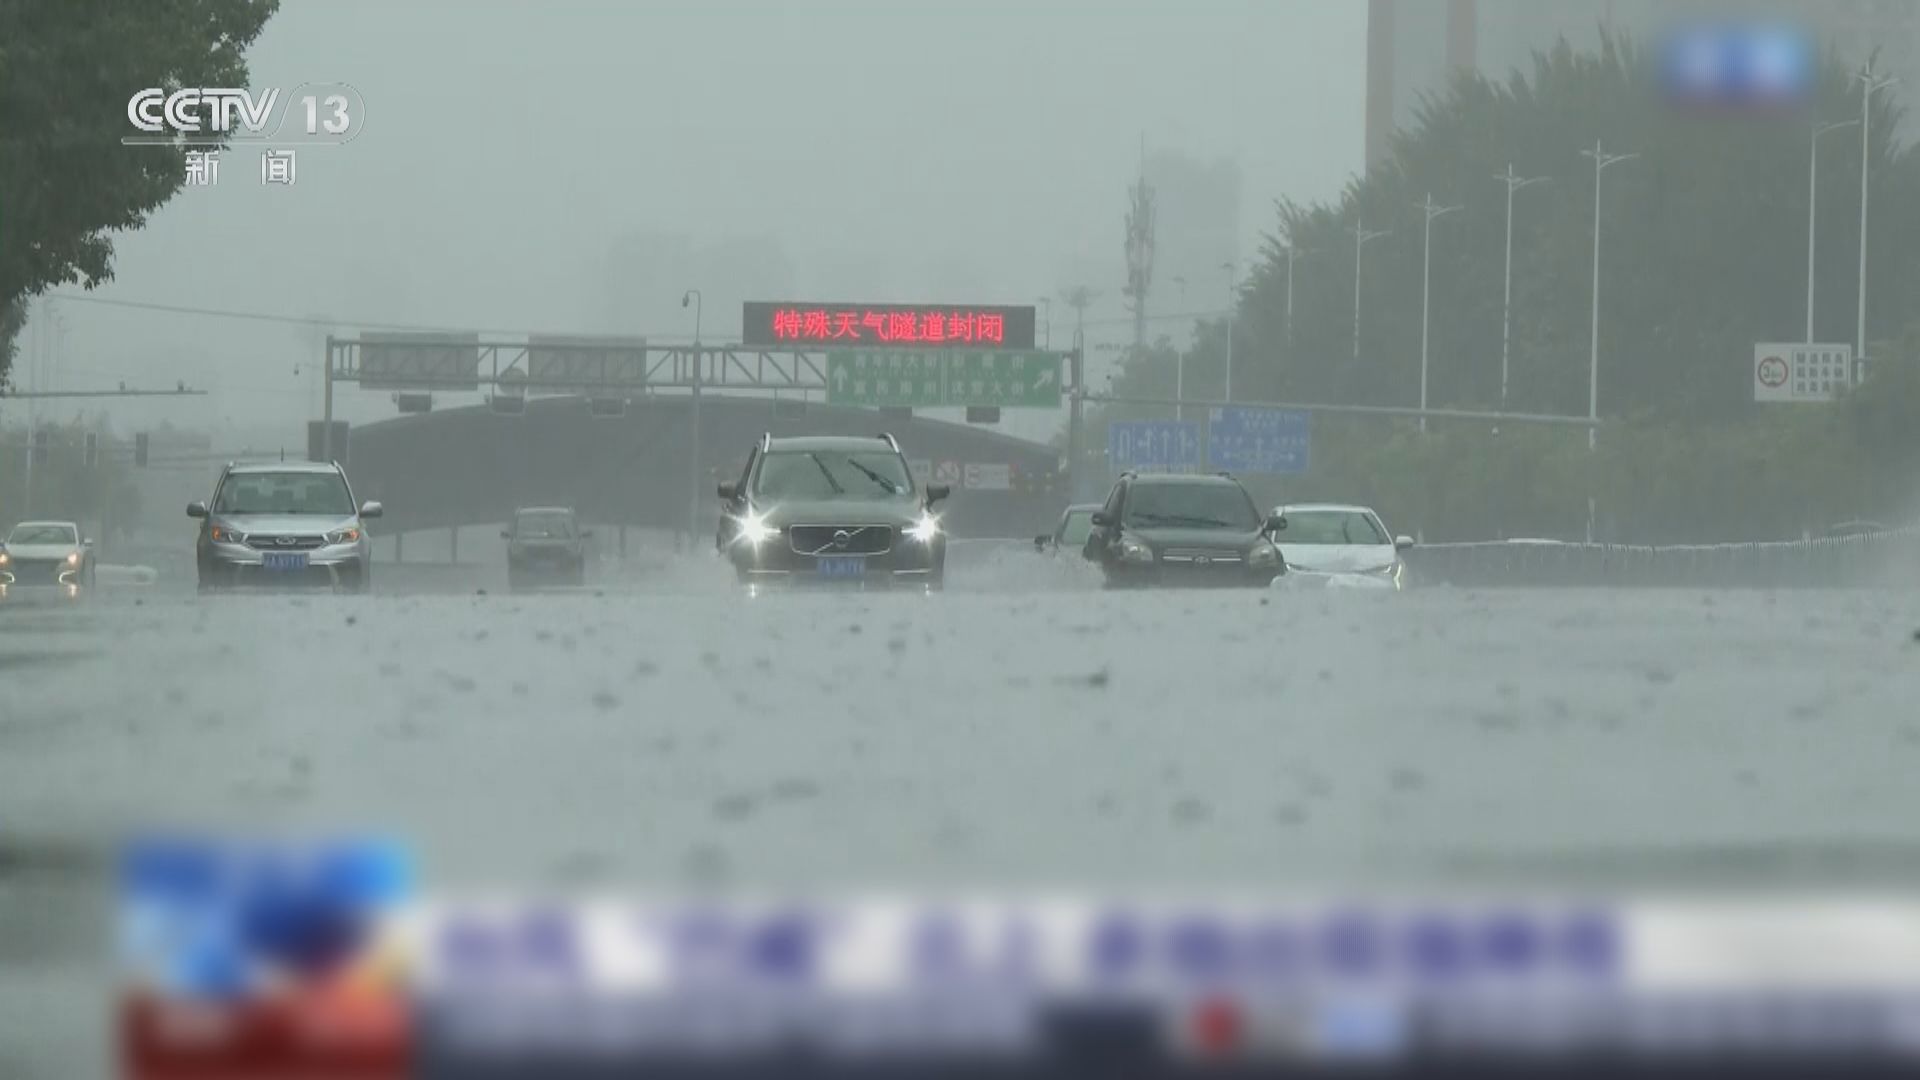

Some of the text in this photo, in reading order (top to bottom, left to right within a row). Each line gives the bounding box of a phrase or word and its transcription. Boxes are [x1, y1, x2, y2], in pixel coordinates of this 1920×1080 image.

[773, 309, 1004, 343] 特殊天气隧道封闭
